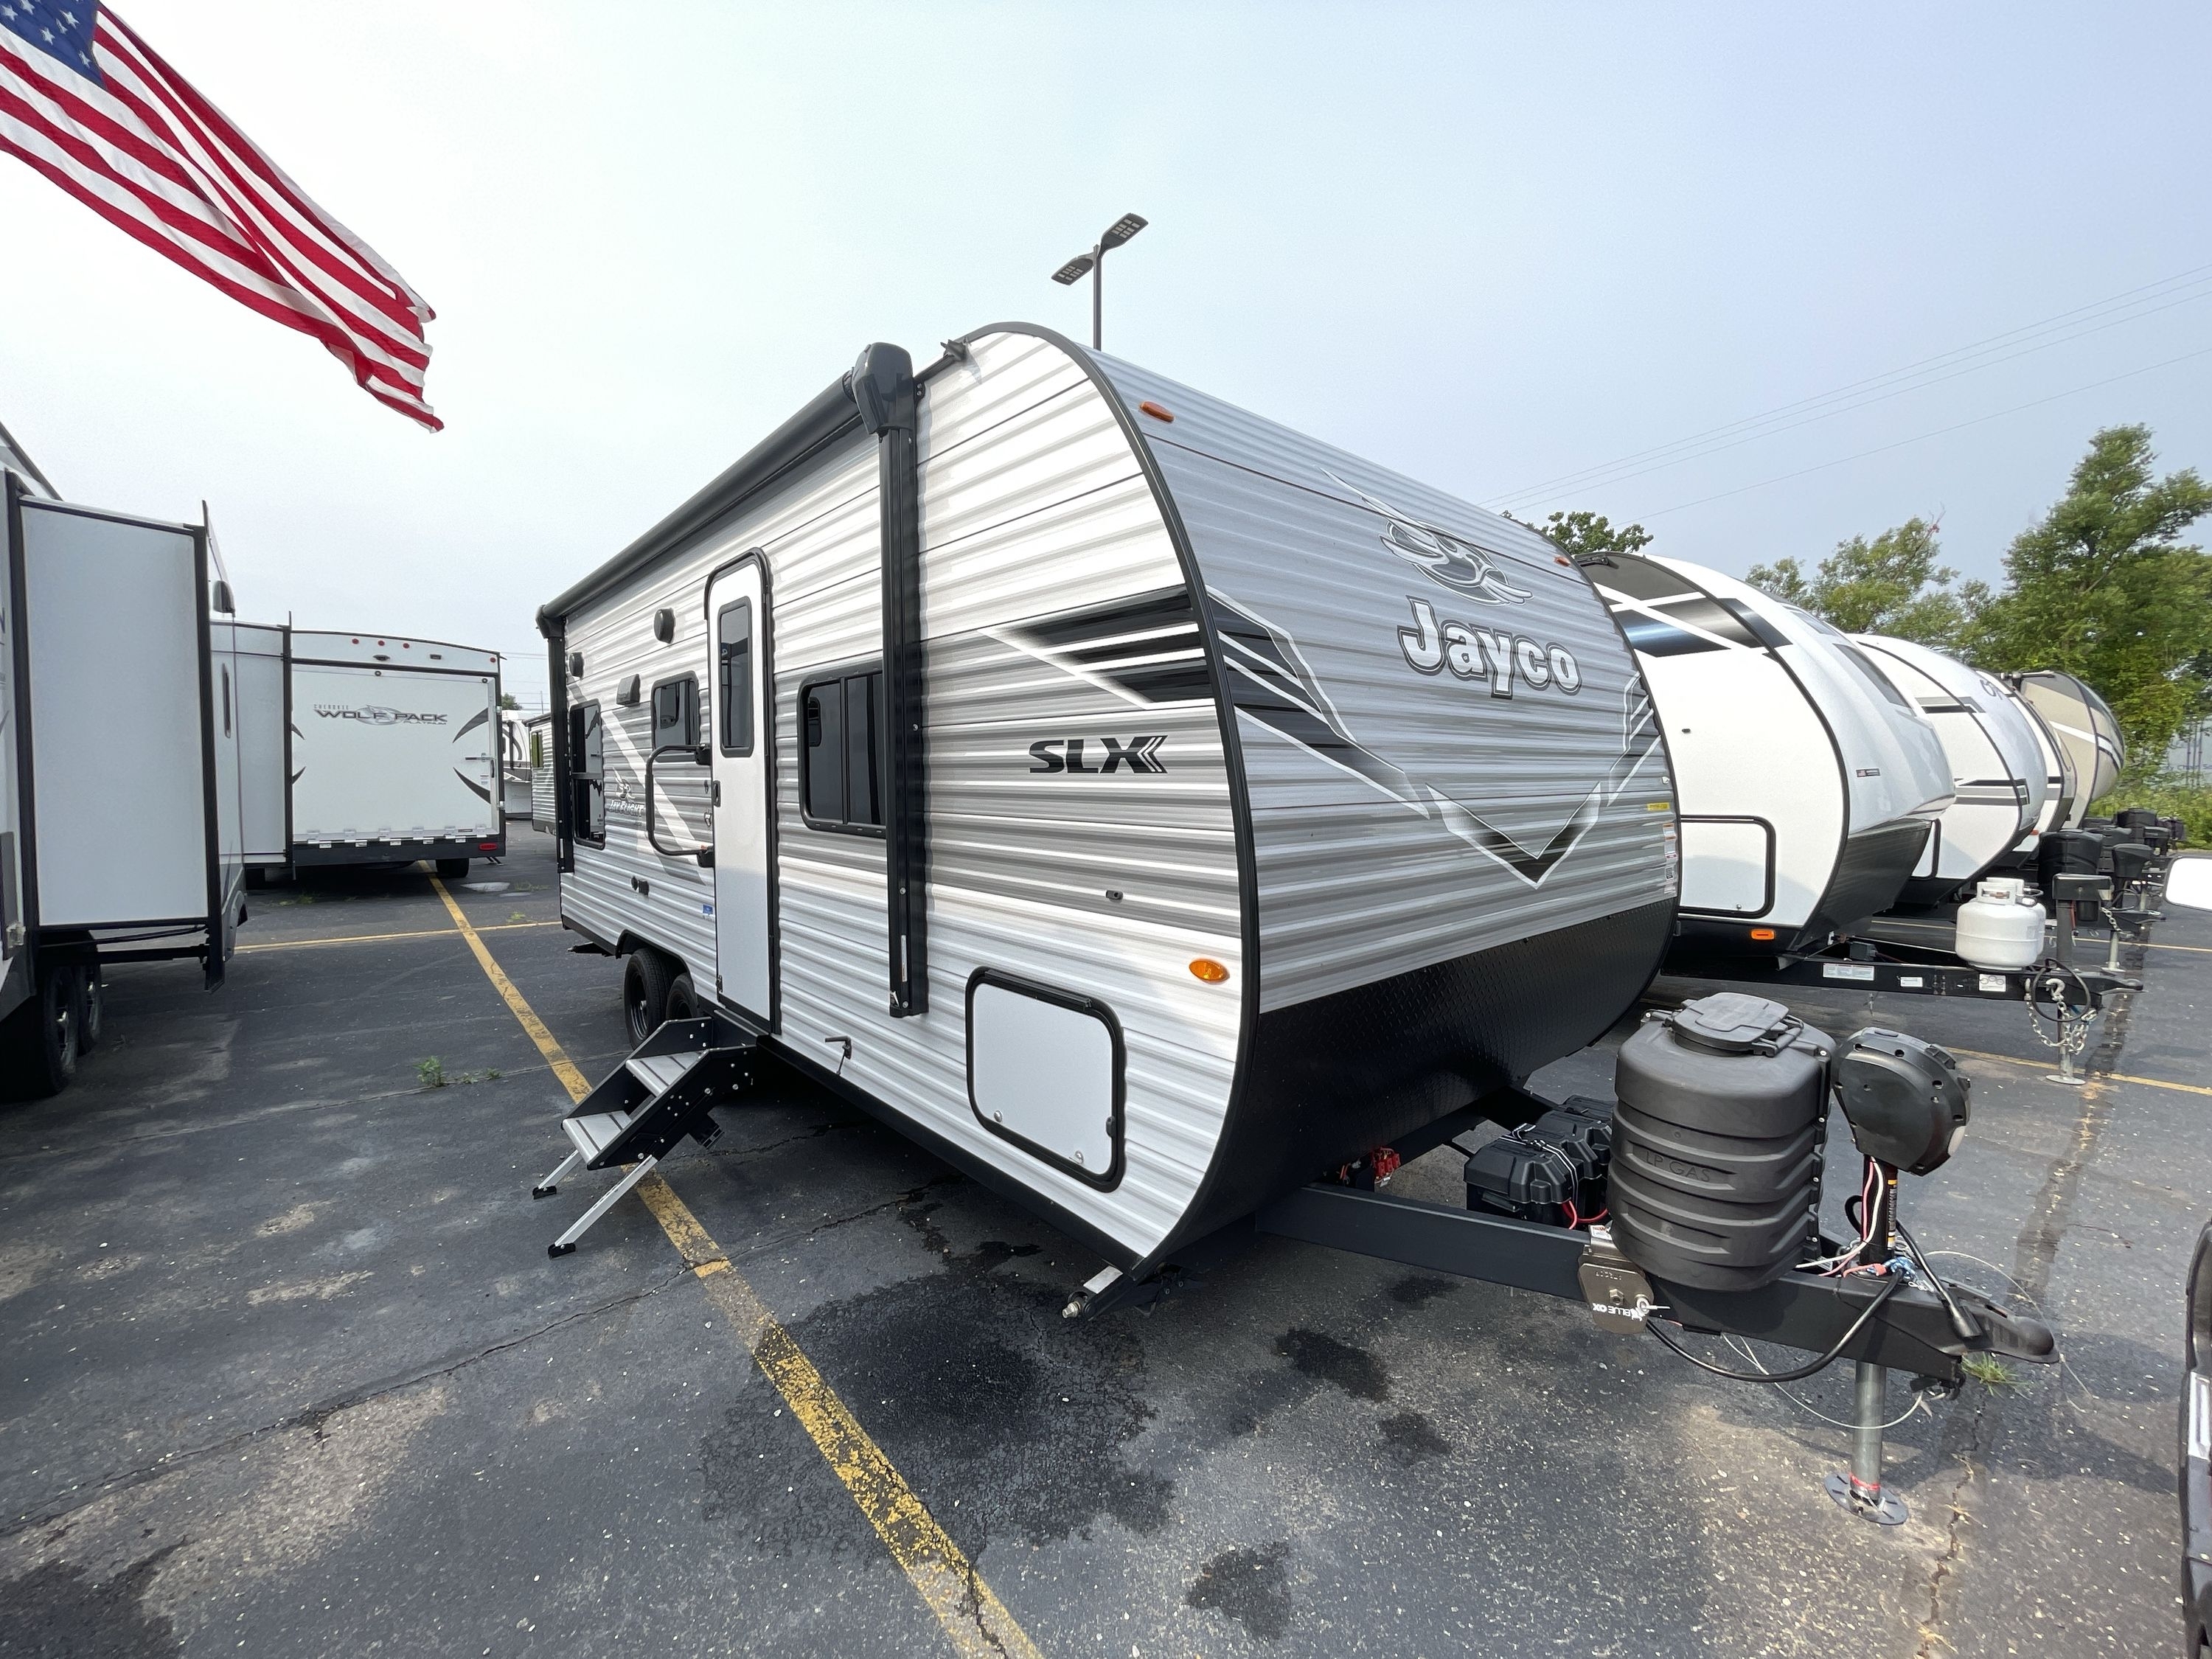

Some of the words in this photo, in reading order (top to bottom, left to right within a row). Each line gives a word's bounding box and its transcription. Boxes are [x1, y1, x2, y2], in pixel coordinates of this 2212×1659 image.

[1397, 595, 1582, 700] Jayco
[313, 709, 387, 720] WOLF
[394, 712, 448, 723] PACK
[1029, 735, 1168, 774] SLX
[1646, 1150, 1664, 1167] LP
[1669, 1161, 1711, 1183] GAS
[1592, 1302, 1607, 1313] OX
[1607, 1305, 1631, 1317] BLUE
